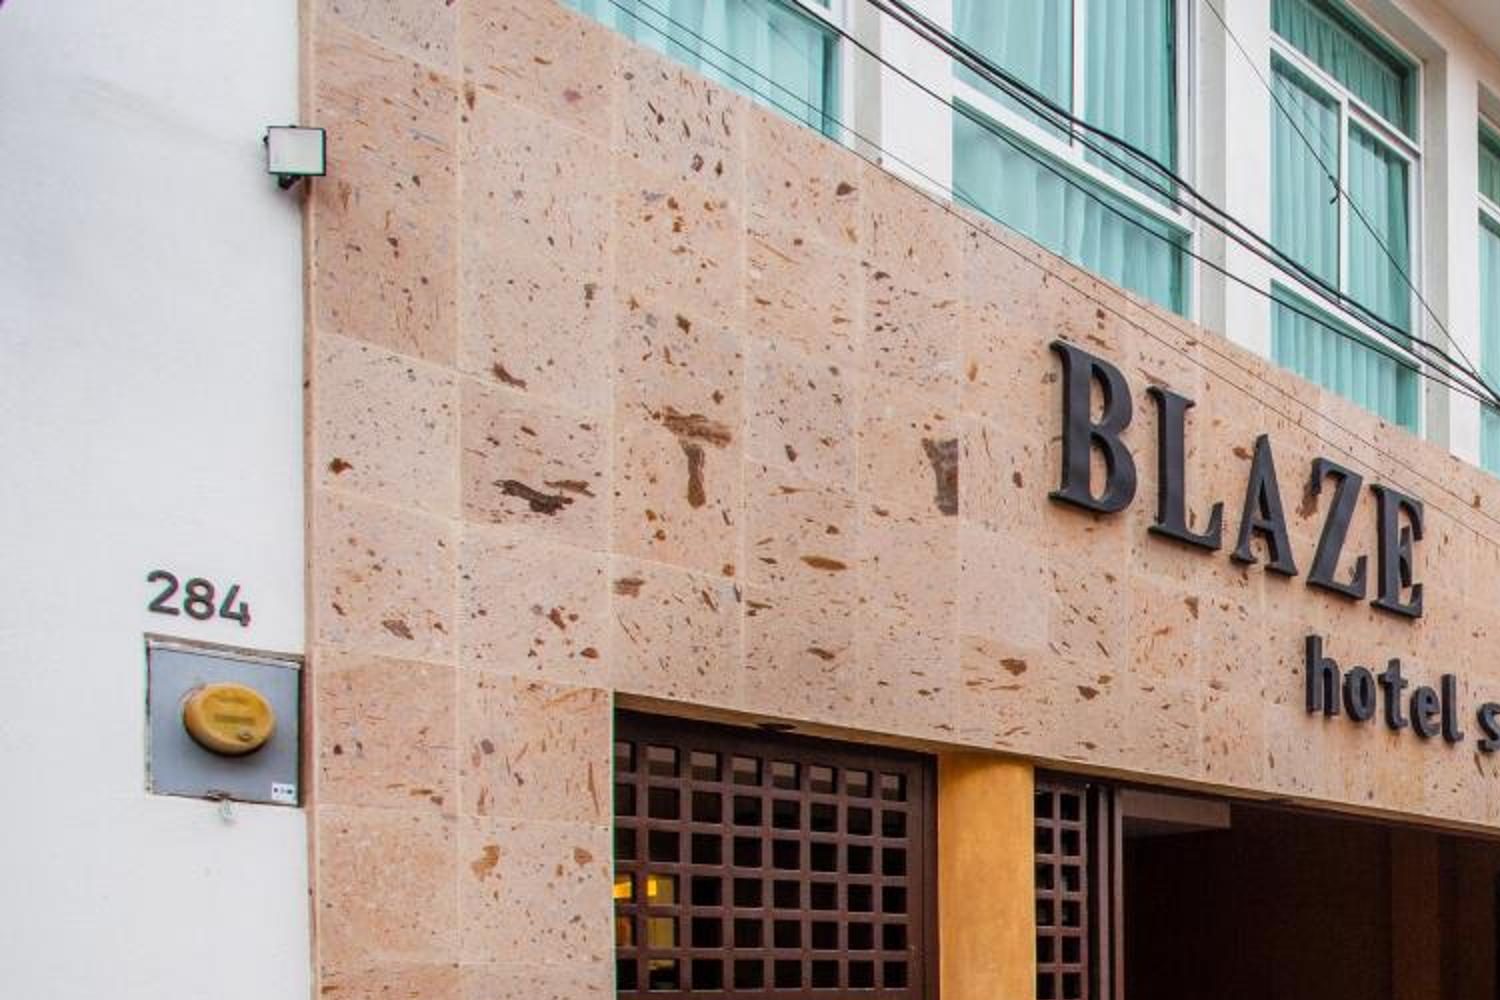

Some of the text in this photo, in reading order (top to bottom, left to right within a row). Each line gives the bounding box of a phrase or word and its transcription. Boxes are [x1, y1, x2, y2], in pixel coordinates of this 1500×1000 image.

[1048, 338, 1425, 619] BLAZE
[147, 570, 251, 627] 284
[1305, 634, 1465, 744] hotel
